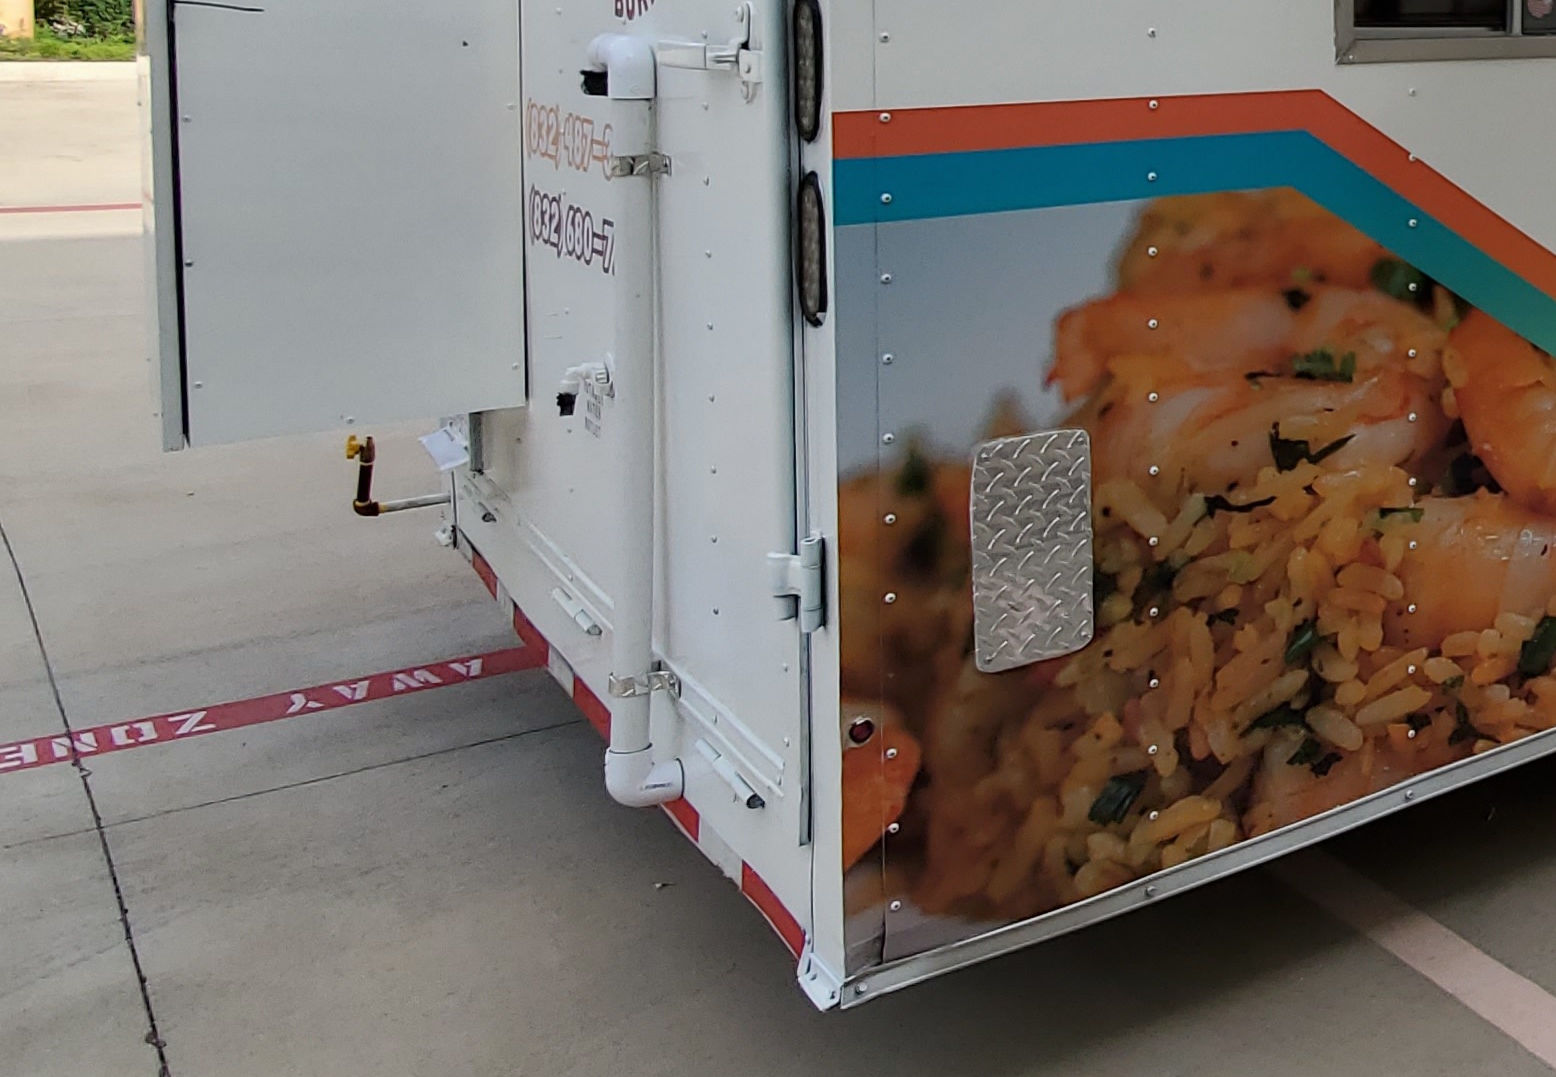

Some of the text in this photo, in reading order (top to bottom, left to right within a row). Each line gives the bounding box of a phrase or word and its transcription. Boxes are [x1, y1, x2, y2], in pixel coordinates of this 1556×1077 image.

[526, 97, 561, 171] (832)
[529, 182, 564, 259] (832)
[0, 657, 484, 768] AWAY ZONE
